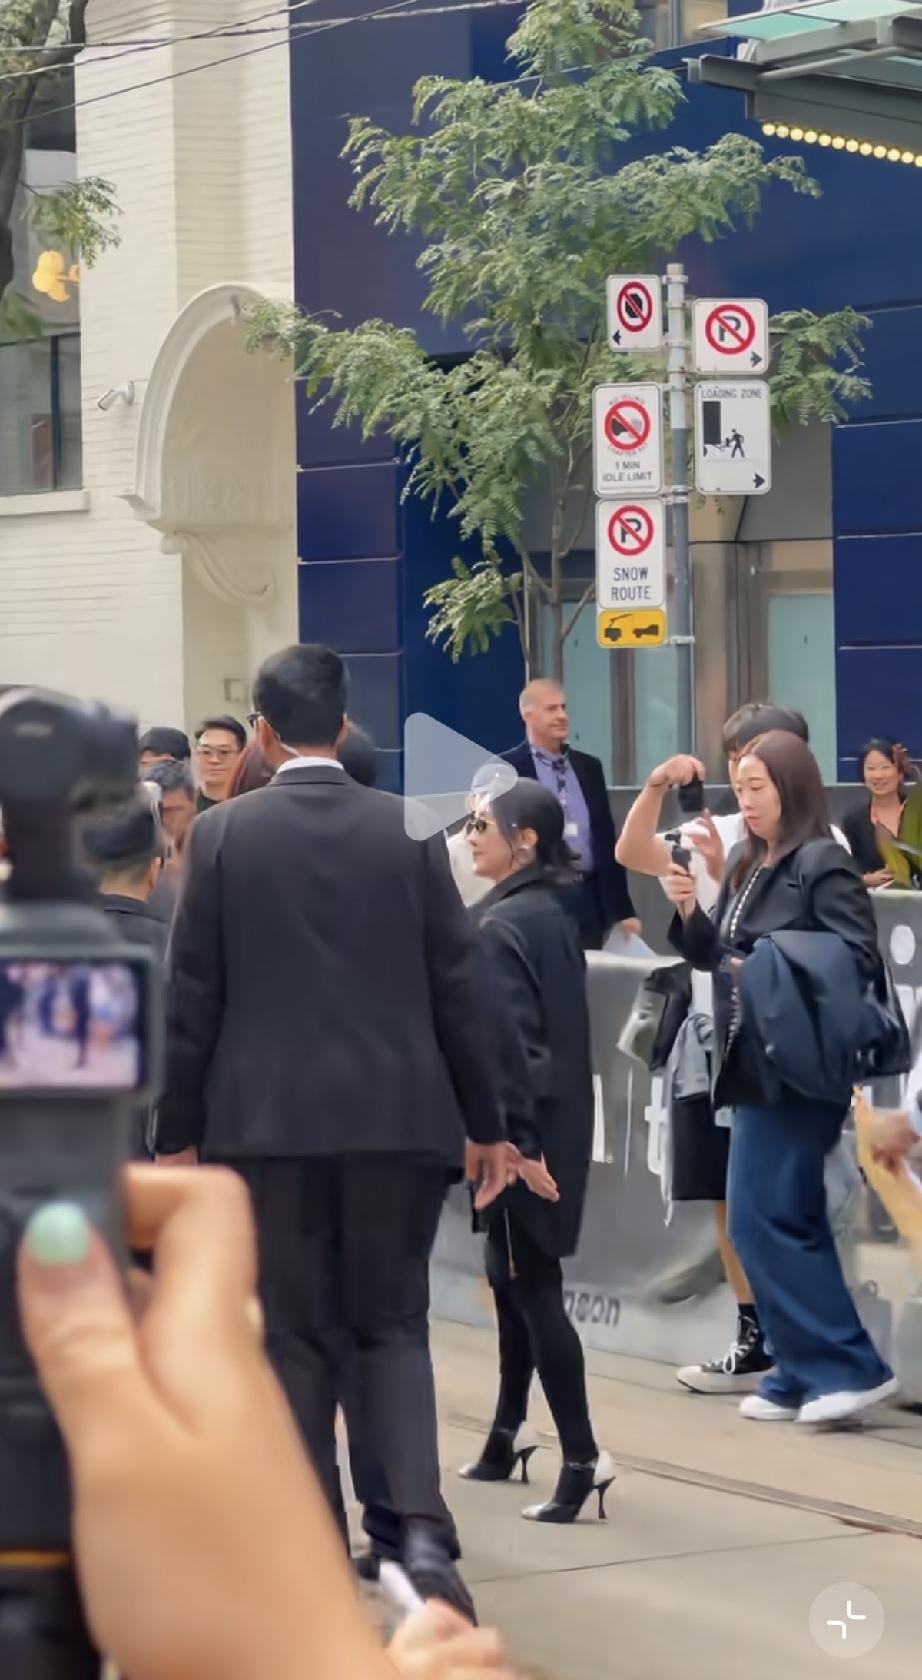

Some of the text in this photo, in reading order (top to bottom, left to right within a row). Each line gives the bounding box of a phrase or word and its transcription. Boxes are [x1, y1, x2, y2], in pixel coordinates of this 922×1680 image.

[701, 387, 762, 399] LOADING ZONE
[615, 461, 641, 470] 1 MIN
[602, 471, 653, 482] IDLE LIMIT
[613, 567, 649, 581] SNOW
[611, 585, 652, 601] ROUTE
